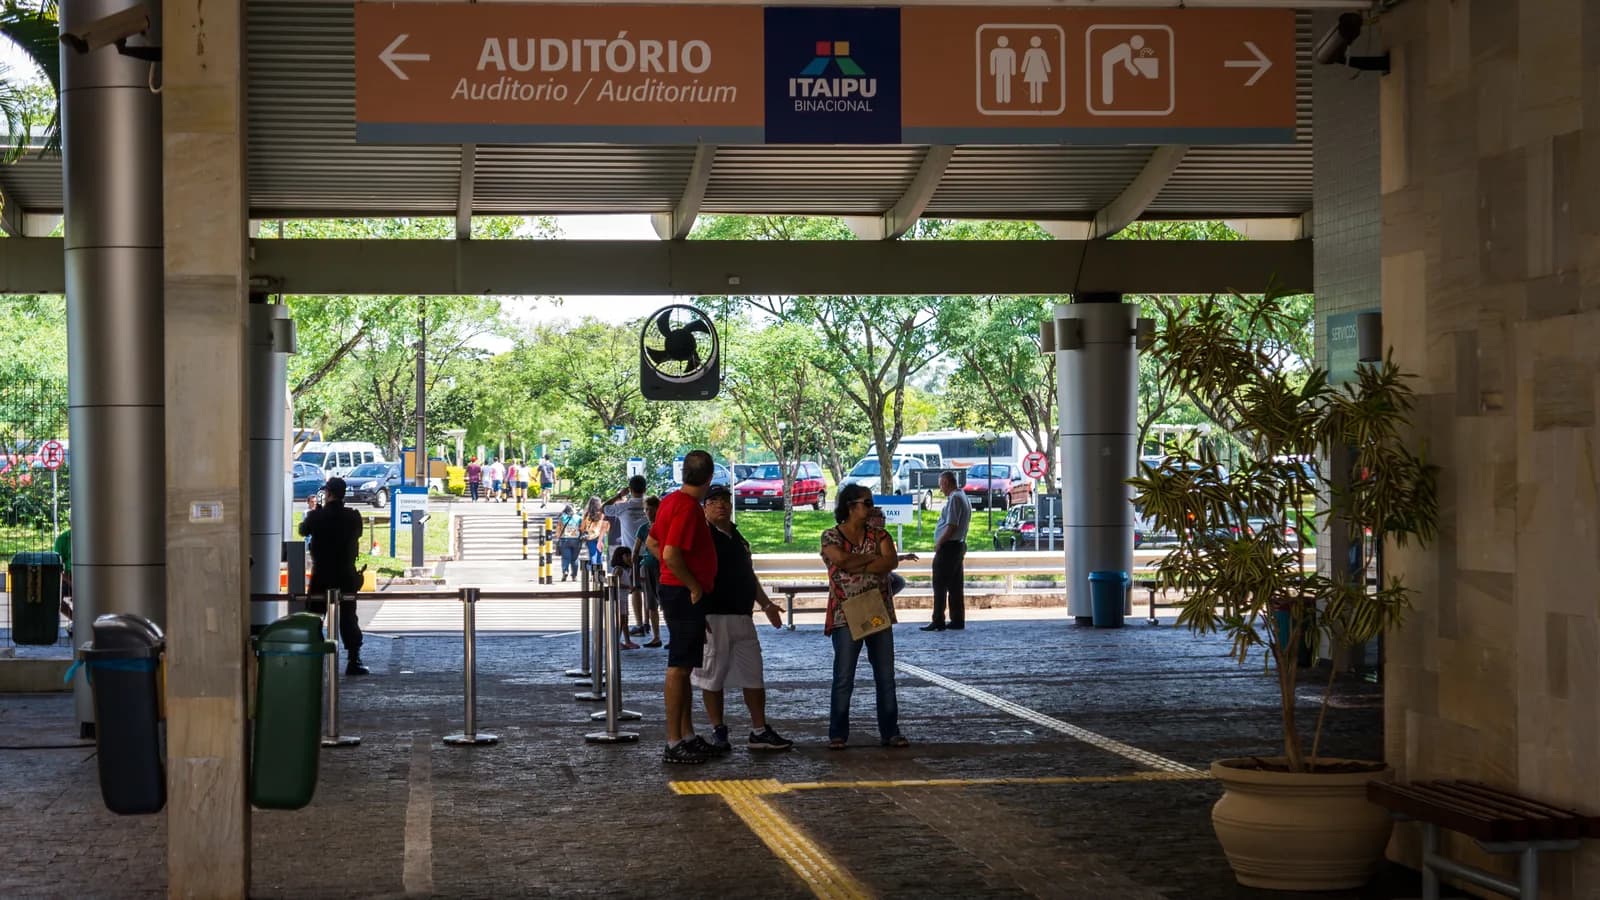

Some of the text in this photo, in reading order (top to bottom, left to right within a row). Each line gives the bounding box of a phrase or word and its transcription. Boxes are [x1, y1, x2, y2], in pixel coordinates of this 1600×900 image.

[476, 30, 712, 74] AUDITÓRIO
[450, 76, 738, 105] Auditorio / Auditorium
[788, 78, 877, 98] ITAIPU
[794, 99, 873, 112] BINACIONAL
